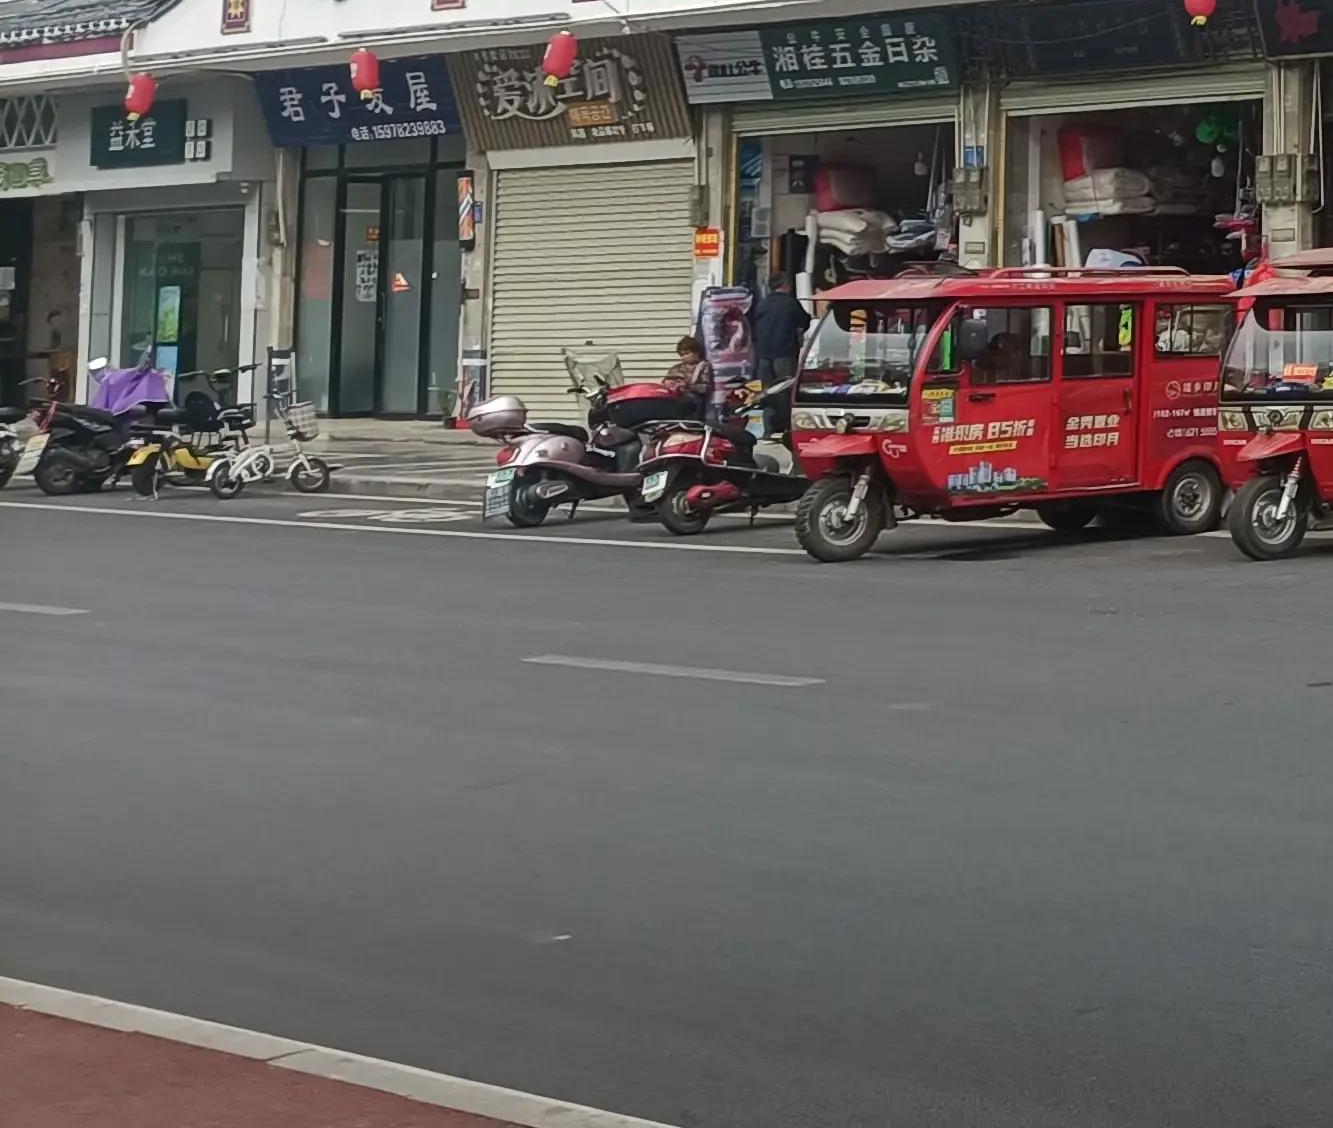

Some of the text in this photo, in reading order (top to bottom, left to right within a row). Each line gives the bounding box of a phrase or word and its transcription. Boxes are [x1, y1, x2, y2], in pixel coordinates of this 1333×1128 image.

[773, 35, 939, 72] 湘桂五金日杂
[109, 118, 157, 151] 益禾堂
